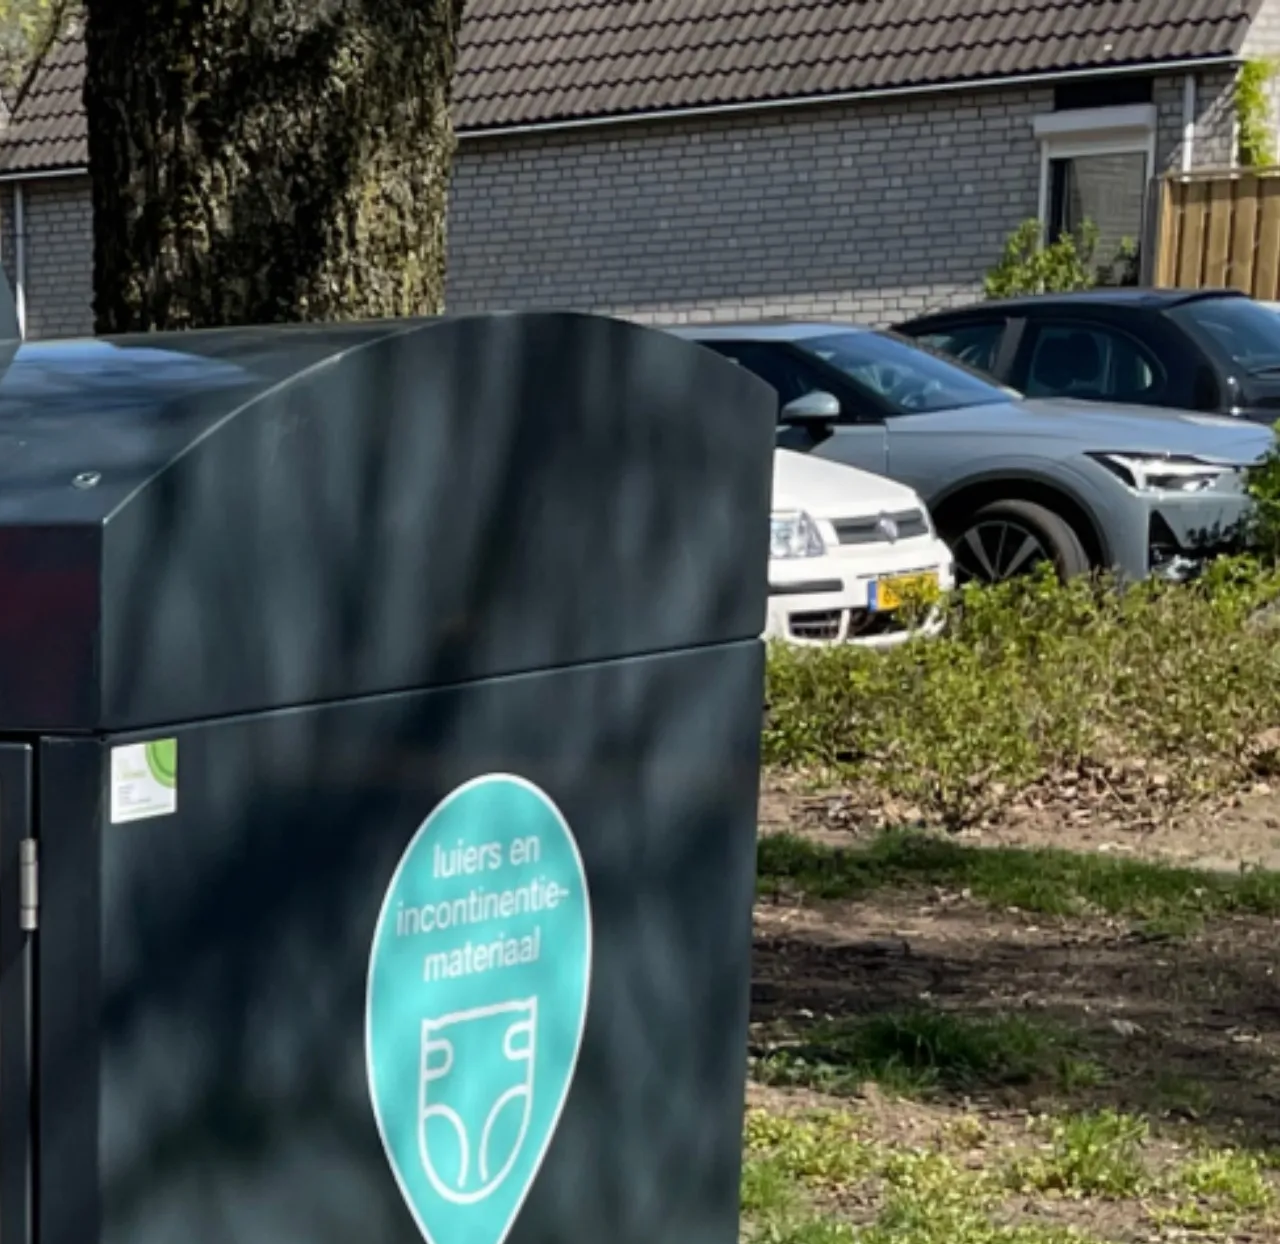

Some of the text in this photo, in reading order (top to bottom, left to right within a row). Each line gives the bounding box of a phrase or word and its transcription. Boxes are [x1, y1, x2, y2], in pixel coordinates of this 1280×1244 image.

[433, 834, 540, 879] luiers en
[396, 874, 571, 936] incontinentie-
[423, 925, 541, 983] materiaal
